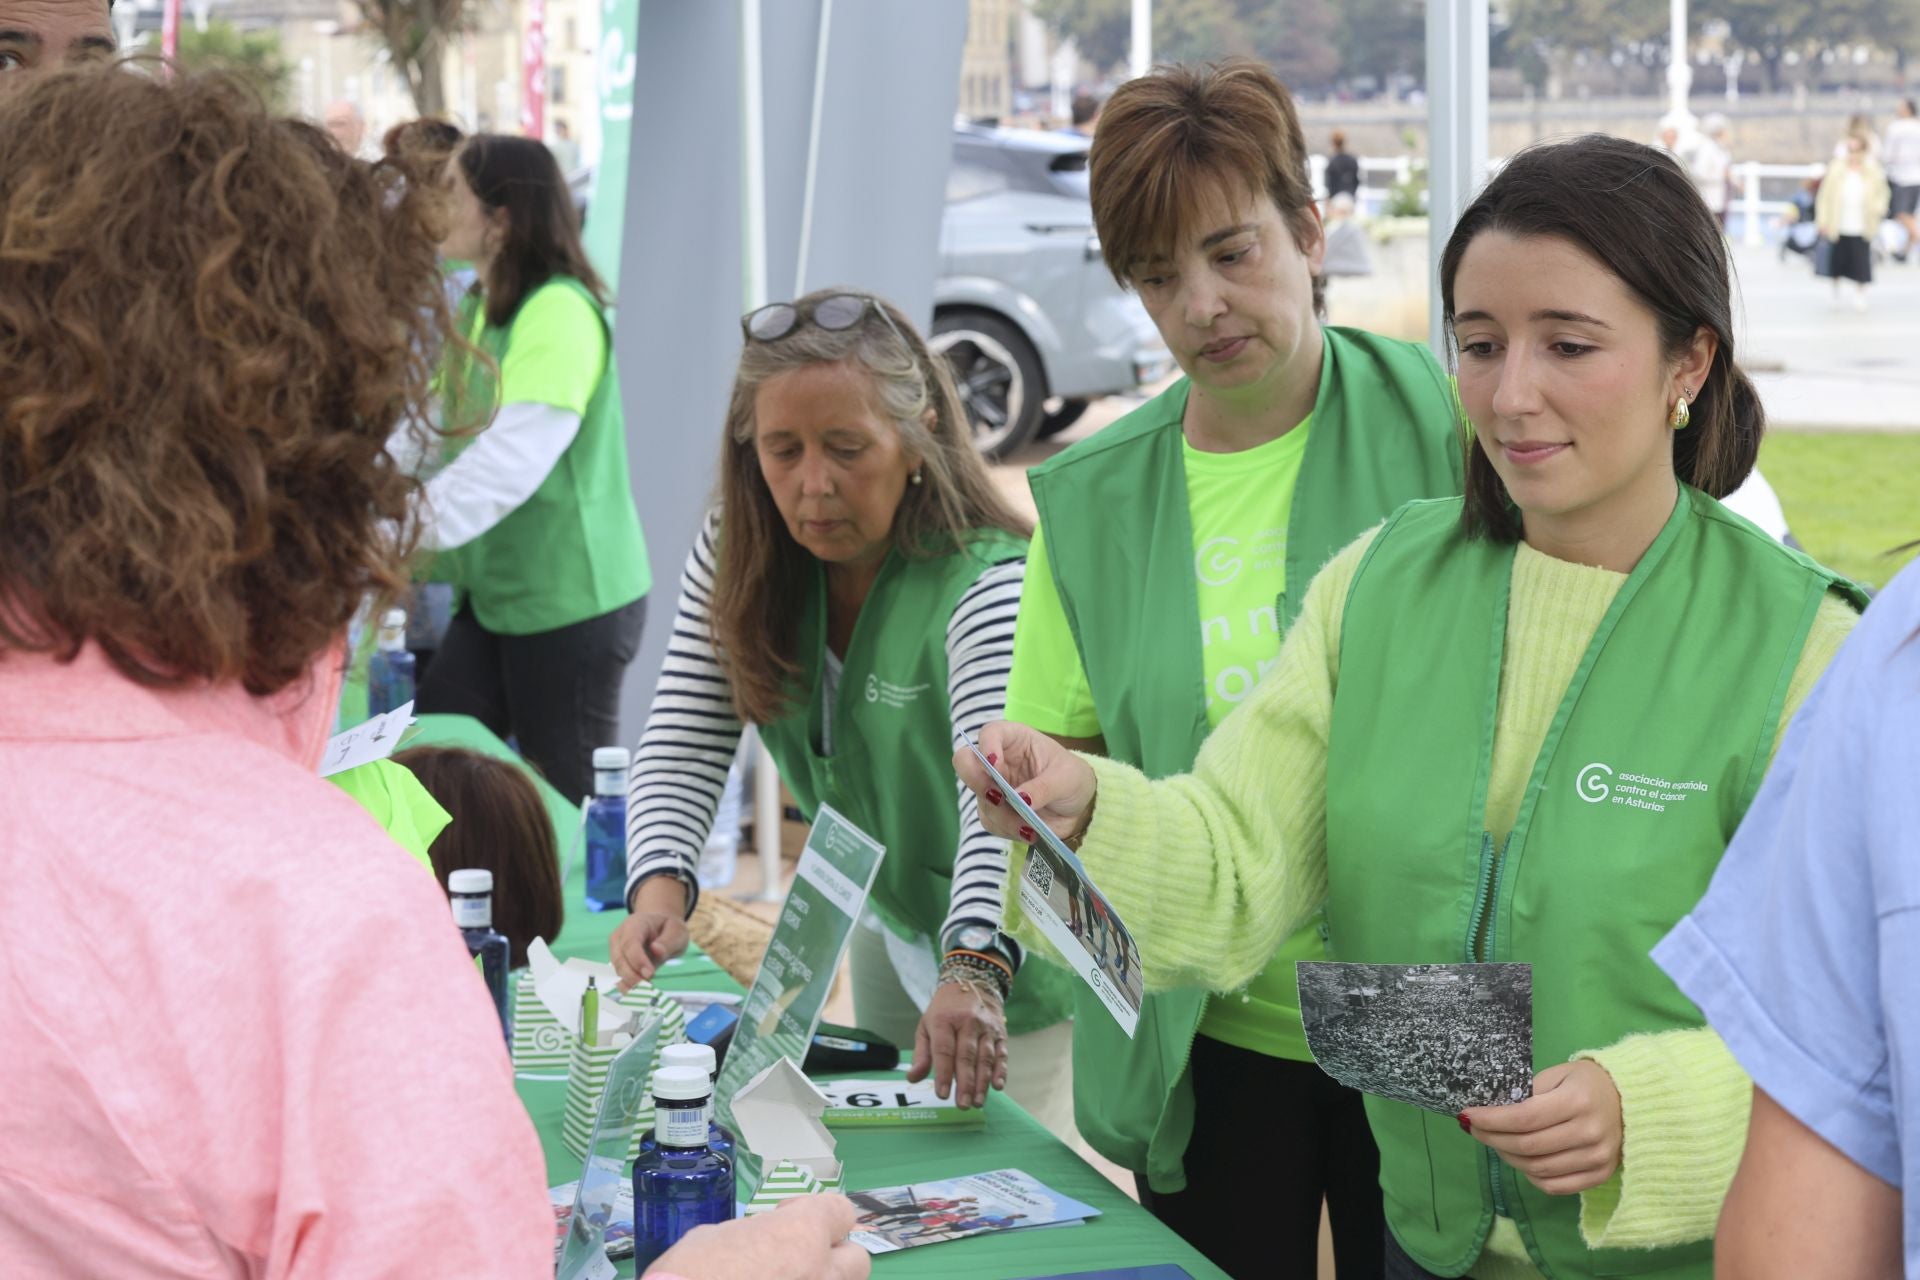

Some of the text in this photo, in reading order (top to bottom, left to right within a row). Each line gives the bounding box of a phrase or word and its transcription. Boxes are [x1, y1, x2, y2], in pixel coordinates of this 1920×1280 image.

[1619, 772, 1708, 792] asociación española
[1615, 784, 1687, 801] contra el cáncer
[1612, 795, 1665, 812] en Asturias
